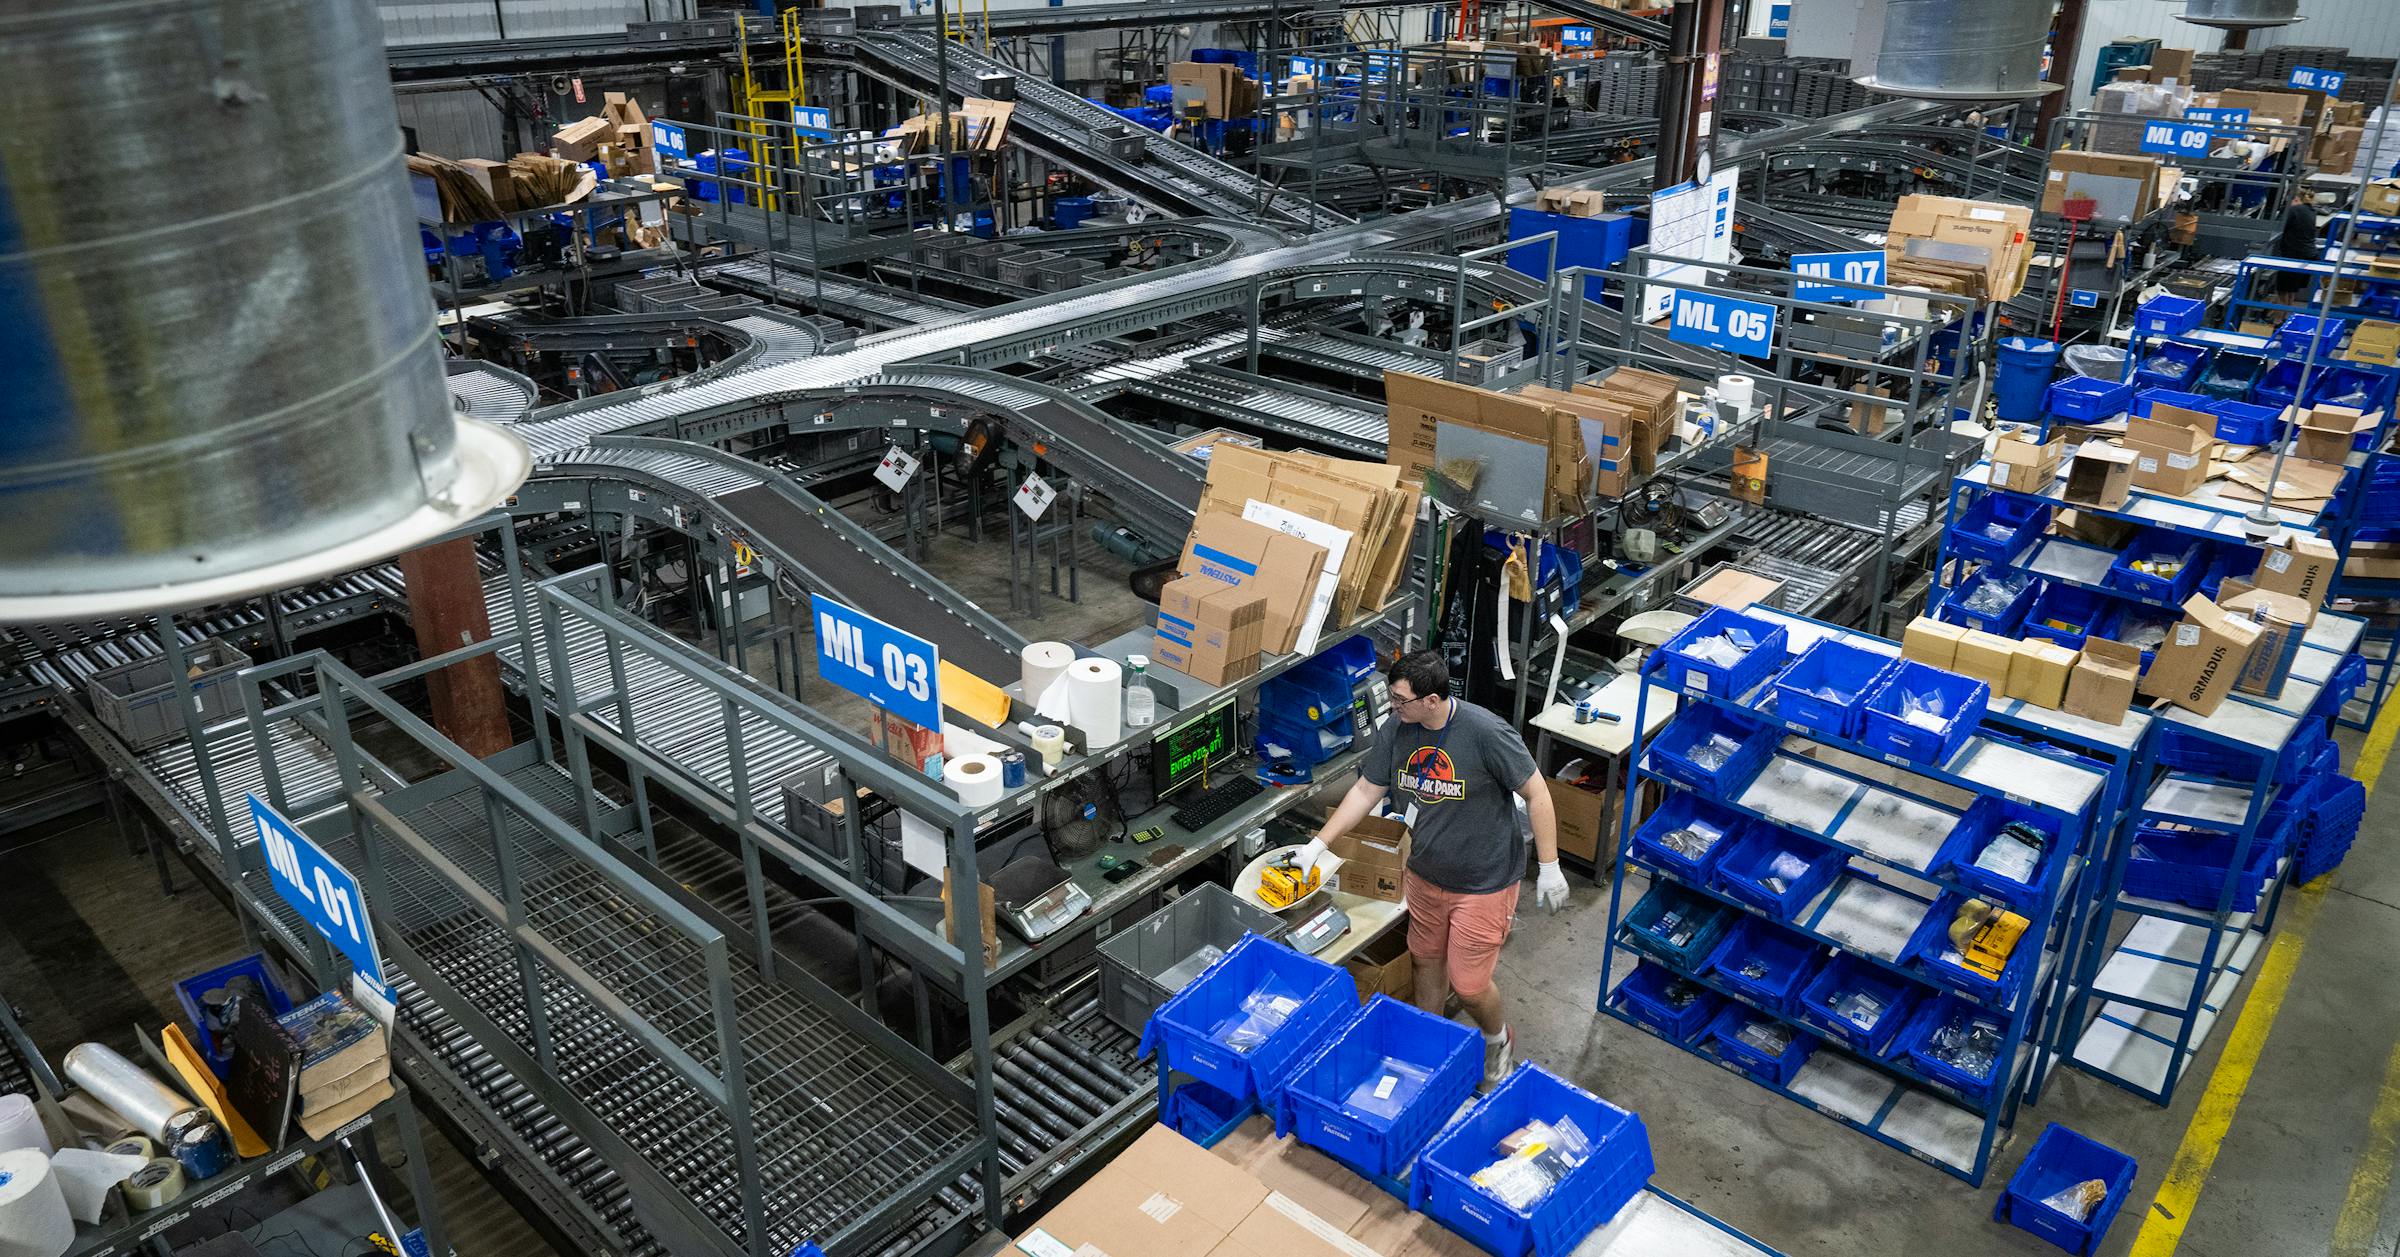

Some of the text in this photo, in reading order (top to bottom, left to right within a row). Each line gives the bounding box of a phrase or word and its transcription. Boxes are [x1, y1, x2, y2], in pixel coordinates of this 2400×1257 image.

[1563, 30, 1592, 42] ML 14
[2291, 70, 2340, 90] ML 13
[795, 111, 828, 129] ML 08
[2188, 112, 2244, 130] ML 11
[653, 126, 684, 151] ML 06
[2145, 126, 2208, 149] ML 09
[1796, 260, 1880, 289] ML 07
[1676, 298, 1768, 342] ML 05
[1200, 563, 1241, 587] FASTENAL
[2297, 564, 2320, 600] MADUS
[820, 611, 930, 702] ML 03
[1170, 737, 1222, 775] ENTER PIC QTY
[1399, 772, 1462, 797] JURASIC PARK
[257, 815, 361, 944] ML 01
